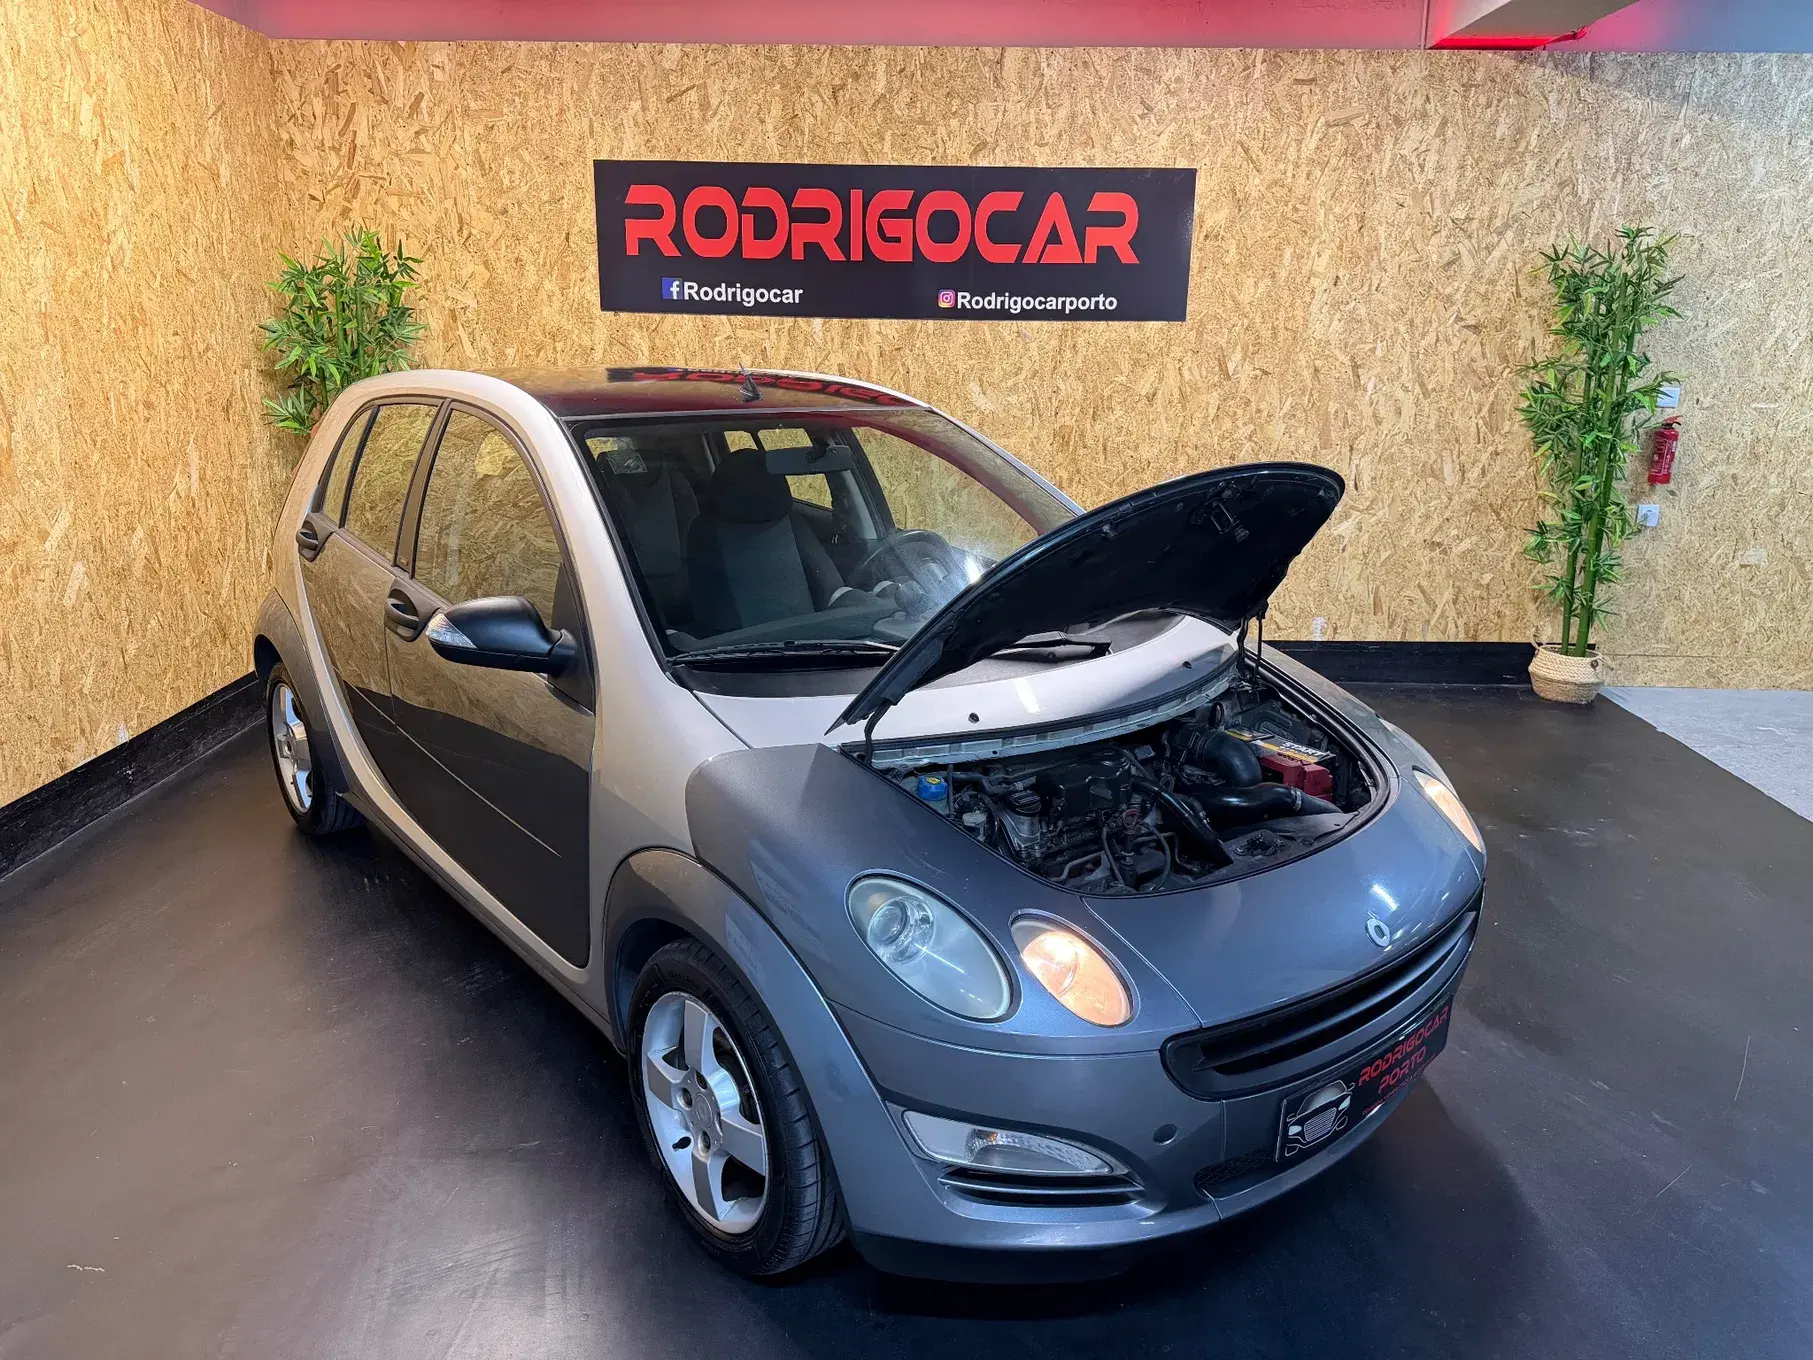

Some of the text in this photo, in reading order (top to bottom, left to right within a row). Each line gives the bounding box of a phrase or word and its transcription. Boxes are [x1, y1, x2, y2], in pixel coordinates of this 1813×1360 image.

[624, 184, 1140, 264] RODRIGOCAR
[683, 281, 804, 307] Rodrigocar
[957, 291, 1118, 314] Rodrigocarporto
[1358, 1005, 1449, 1087] RODRIGOCAR
[1378, 1045, 1427, 1095] PORTO
